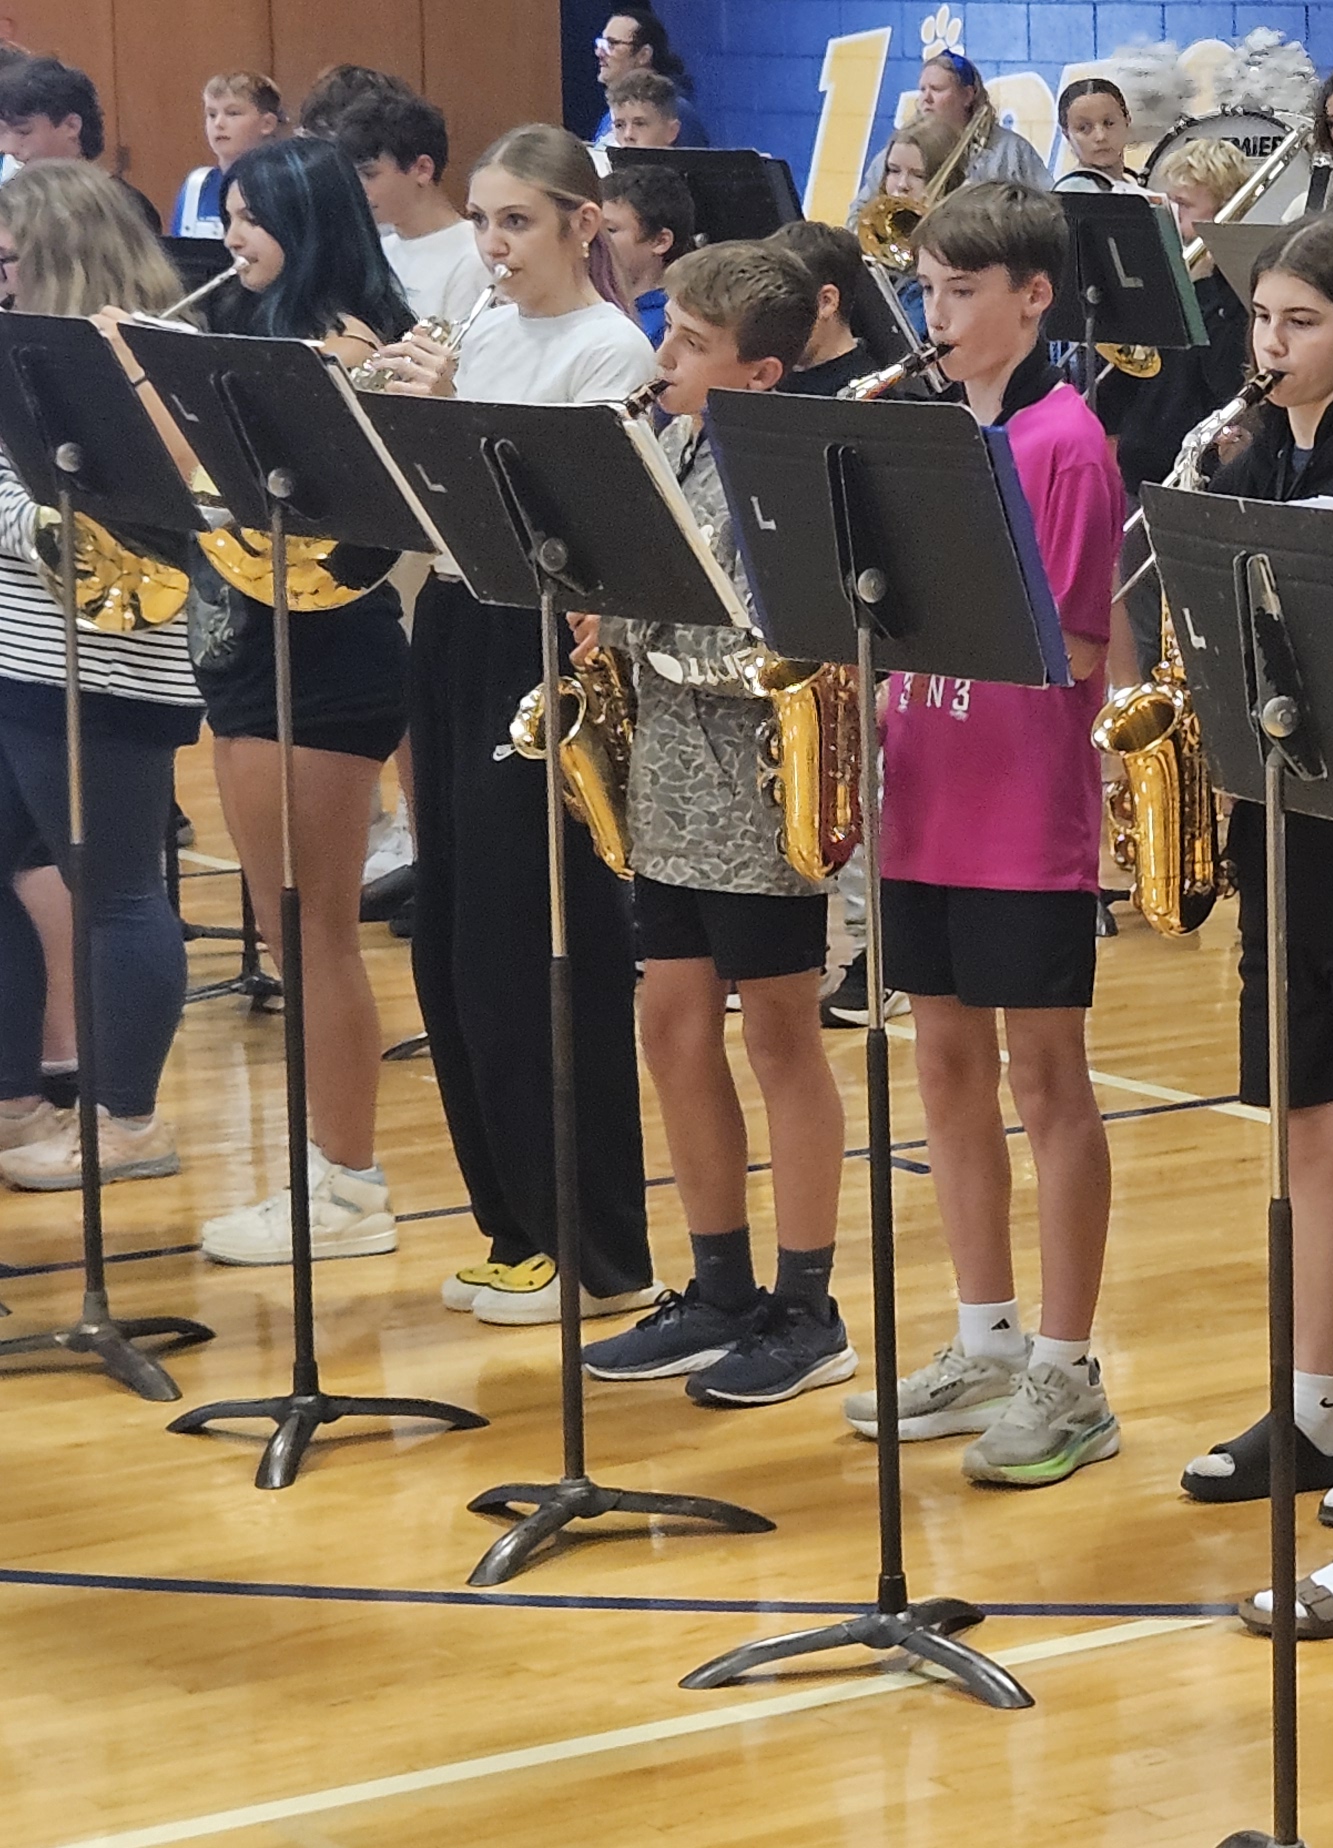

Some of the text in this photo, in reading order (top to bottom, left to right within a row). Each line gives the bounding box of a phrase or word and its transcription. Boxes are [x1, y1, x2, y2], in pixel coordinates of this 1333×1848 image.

[1107, 237, 1144, 288] L
[413, 462, 448, 493] L
[750, 495, 777, 530] L
[1181, 607, 1207, 650] L
